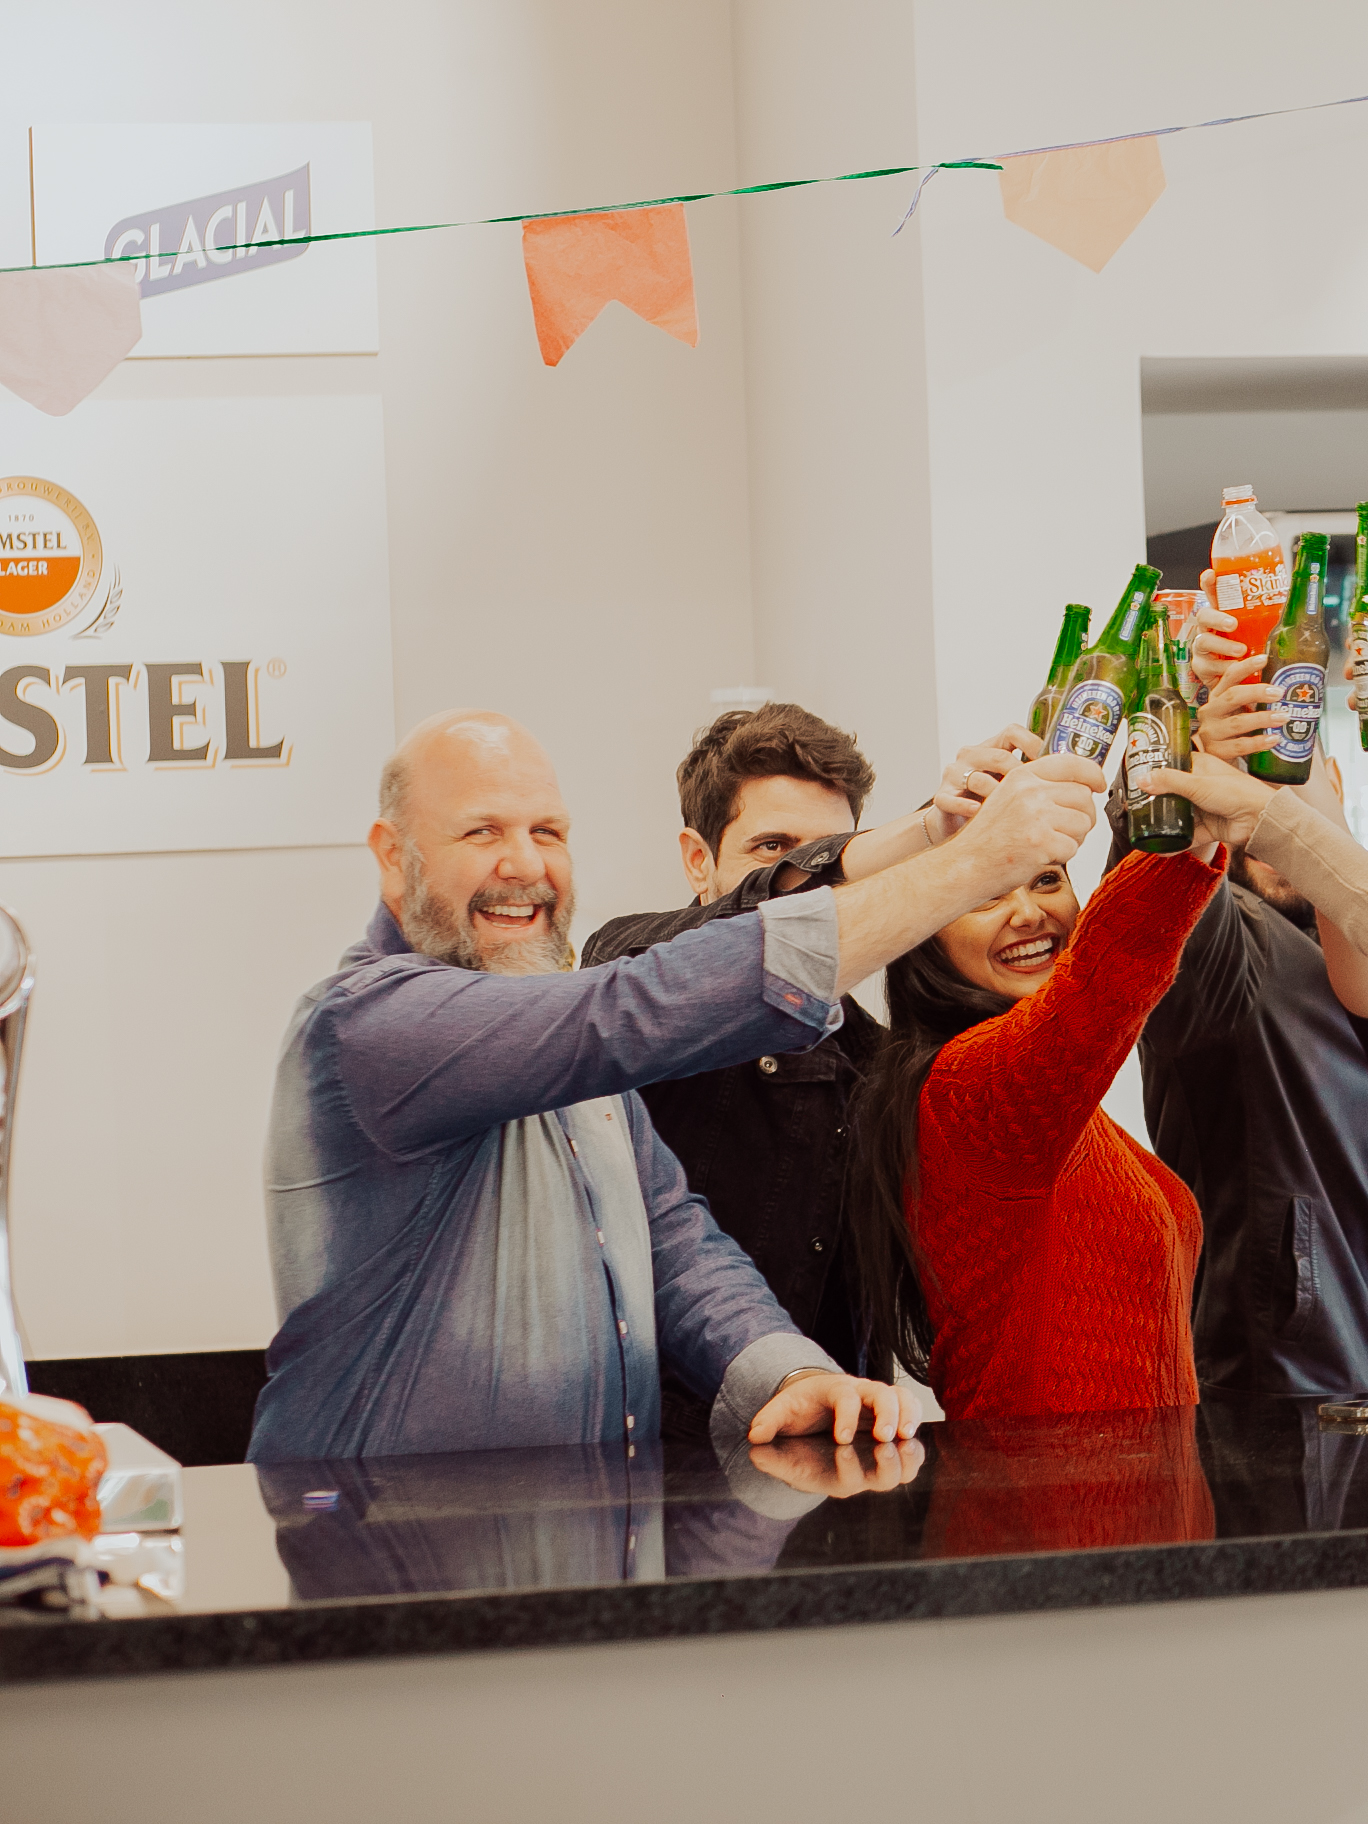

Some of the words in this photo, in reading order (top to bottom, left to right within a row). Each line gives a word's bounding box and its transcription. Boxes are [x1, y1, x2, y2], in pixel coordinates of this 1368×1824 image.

[111, 188, 307, 284] GLACIAL
[8, 514, 35, 523] 1870
[0, 560, 48, 576] LAGER
[41, 568, 96, 630] HOLLAND
